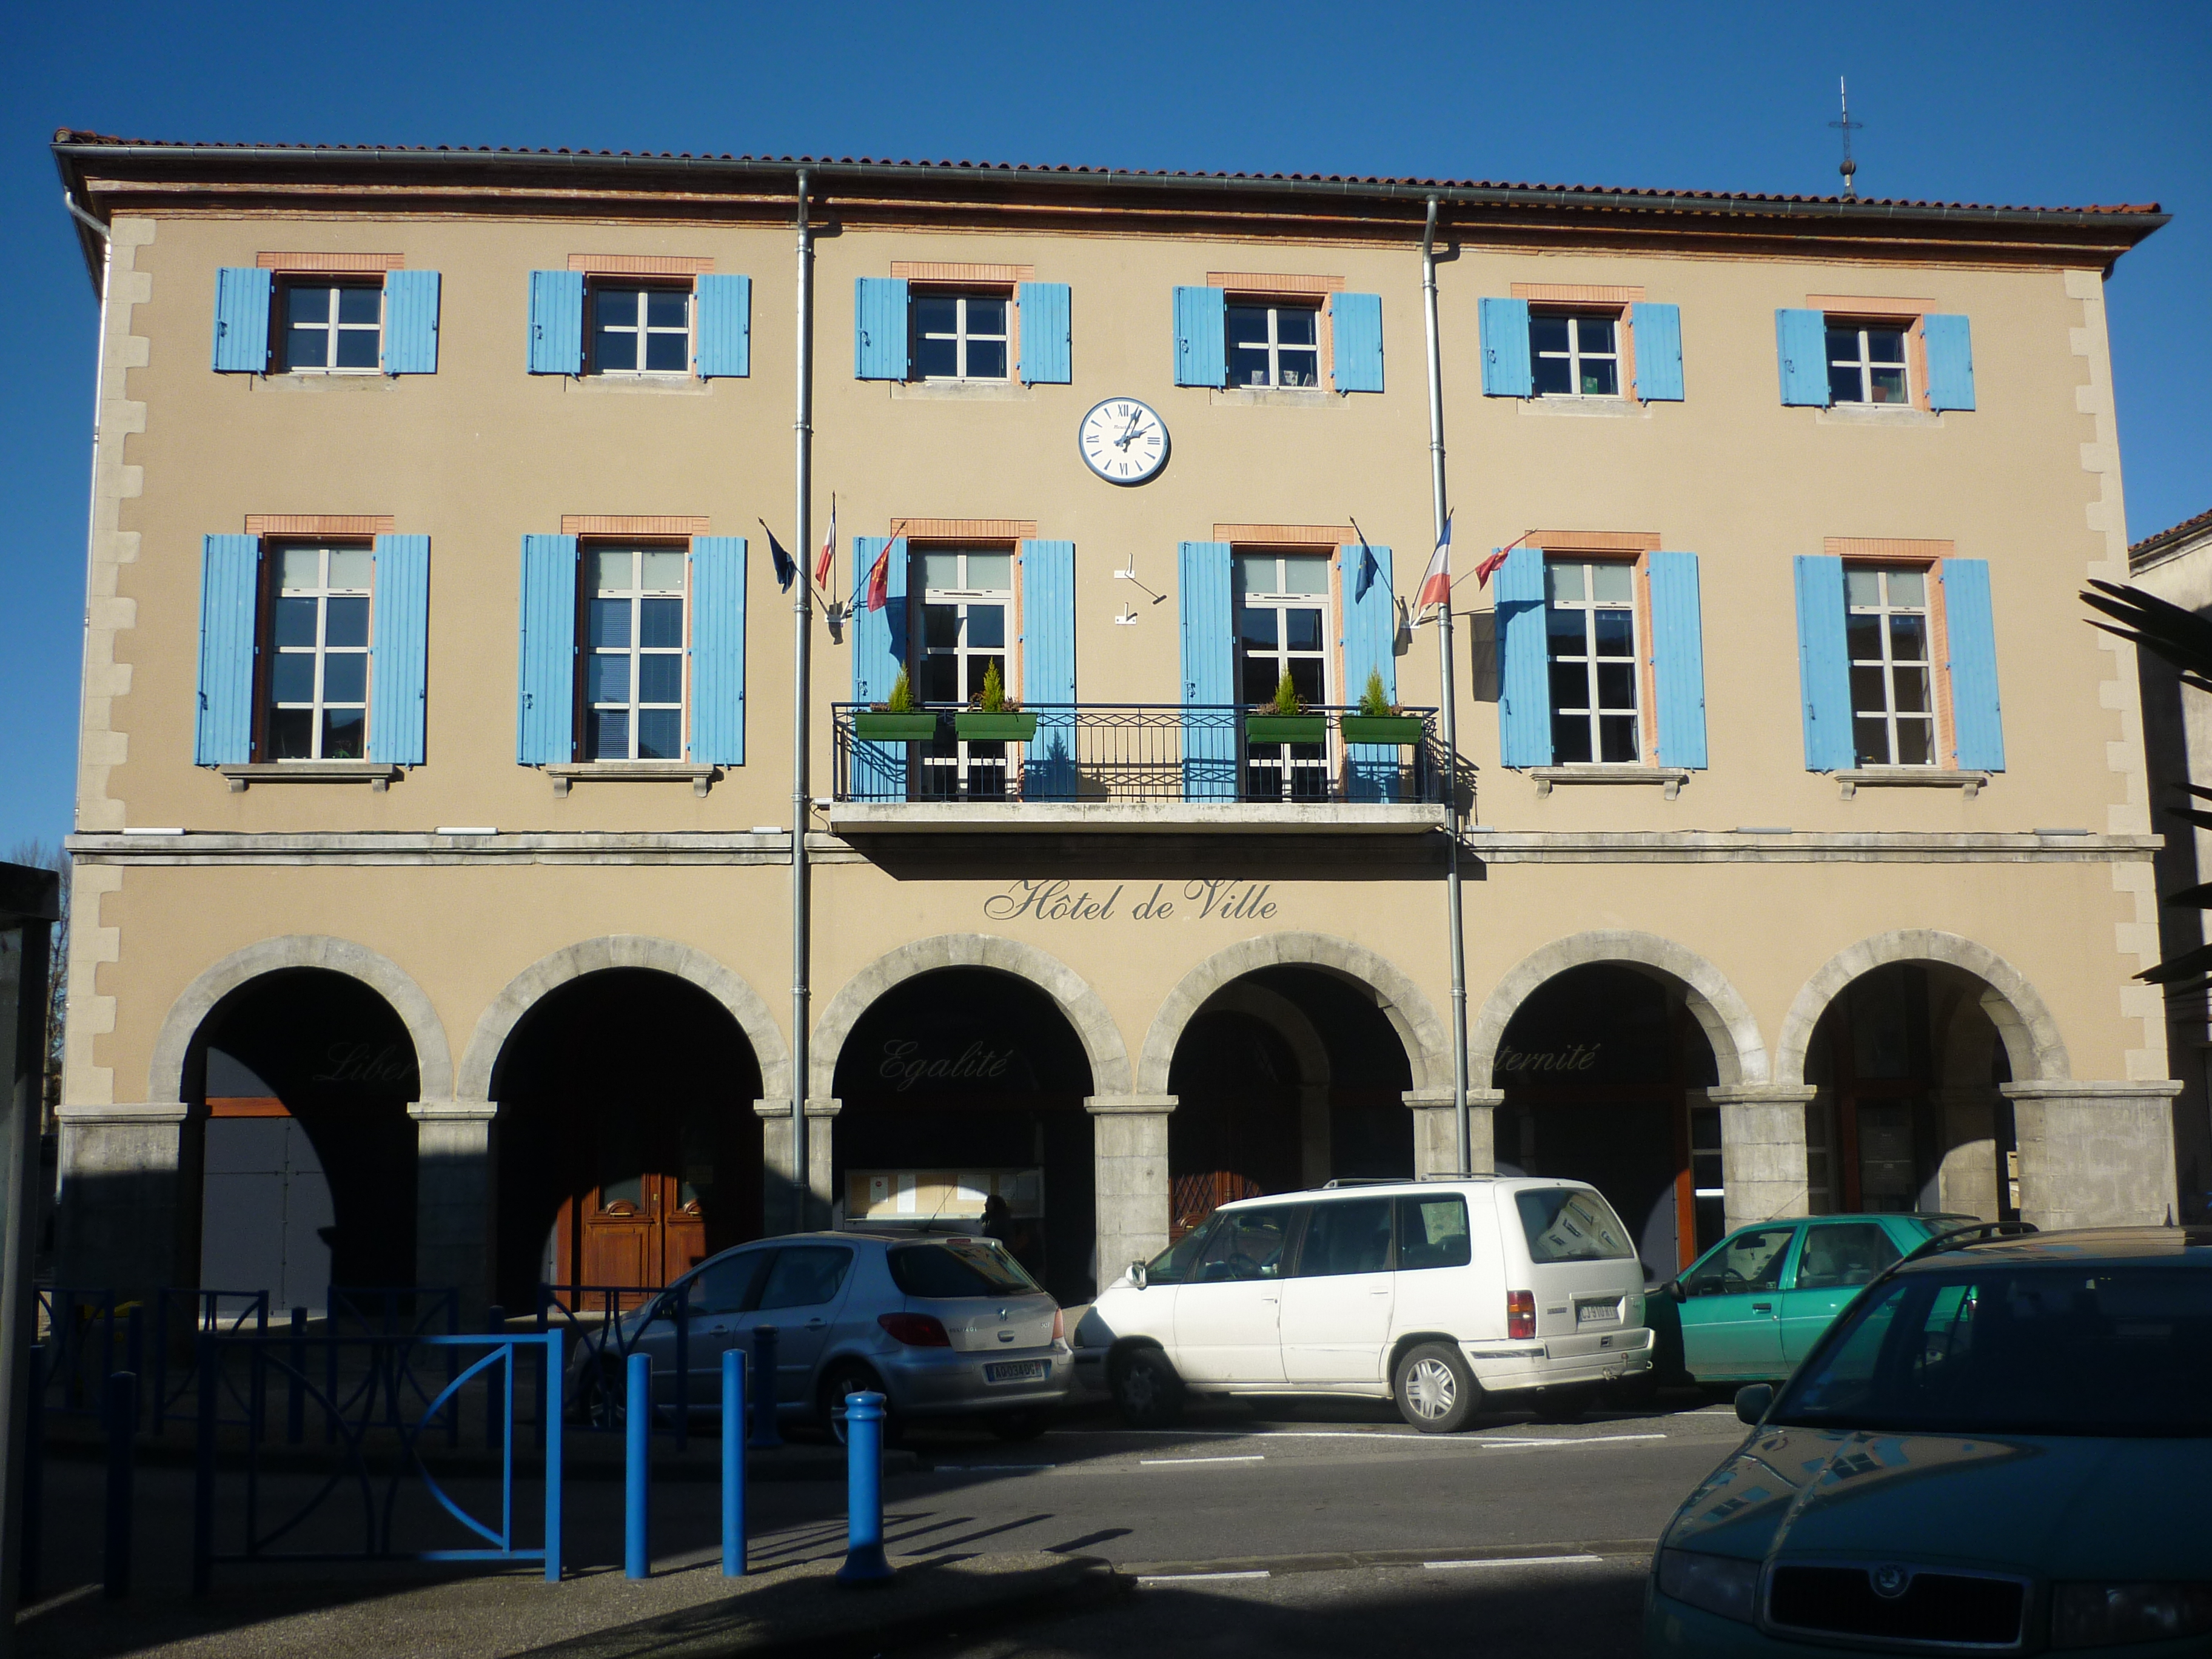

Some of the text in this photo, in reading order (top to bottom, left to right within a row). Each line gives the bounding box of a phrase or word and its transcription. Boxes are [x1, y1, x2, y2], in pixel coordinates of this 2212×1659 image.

[1118, 404, 1128, 417] XII
[1147, 437, 1161, 445] III
[1119, 463, 1128, 475] VI
[984, 877, 1278, 920] Hôtel de Ville
[312, 1042, 419, 1081] Liber
[880, 1039, 1014, 1091] Egalité
[1493, 1042, 1601, 1071] ternité
